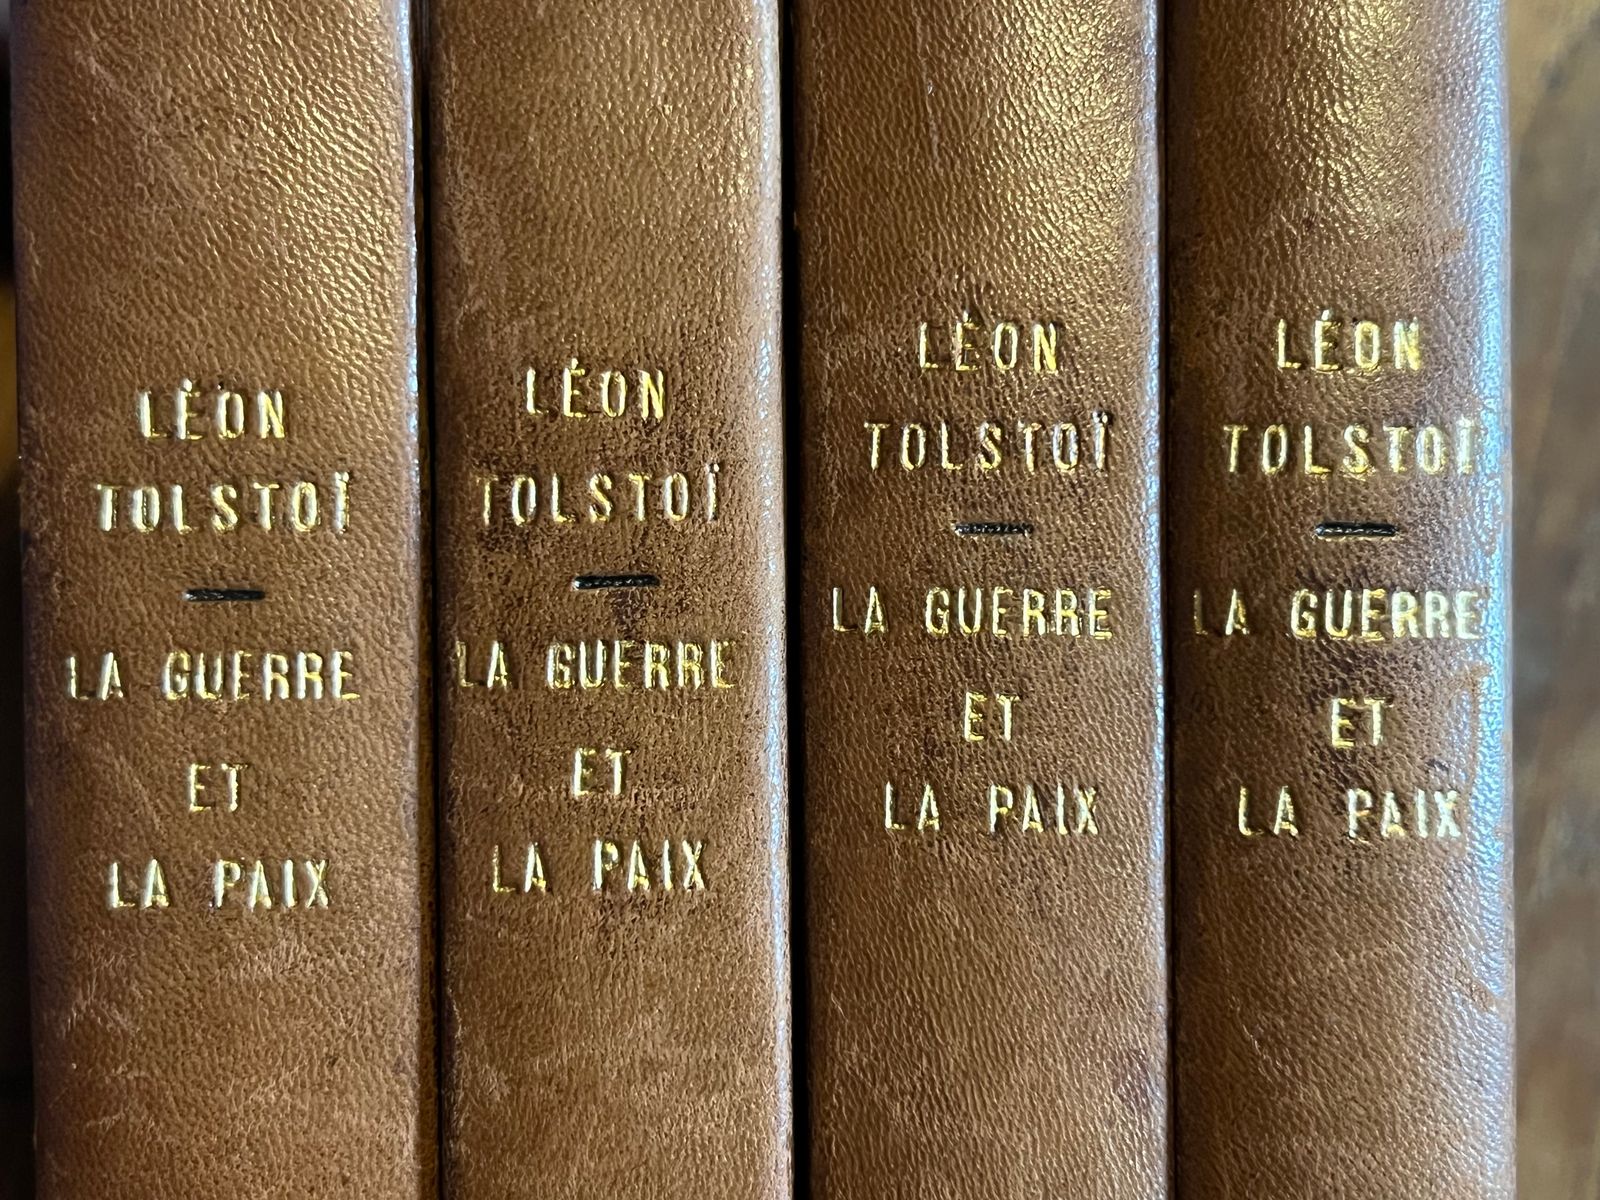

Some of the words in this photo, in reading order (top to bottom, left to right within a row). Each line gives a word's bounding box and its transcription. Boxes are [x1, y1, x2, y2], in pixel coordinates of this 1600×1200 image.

[919, 310, 1058, 374] LÉON
[1277, 308, 1421, 373] LÉON
[137, 378, 285, 440] LÉON
[526, 358, 664, 420] LÉON
[864, 411, 1110, 474] TOLSTOÏ
[94, 471, 350, 535] TOLSTOÏ
[475, 463, 720, 526] TOLSTOÏ
[833, 586, 888, 635] LA
[925, 586, 1113, 640] GUERRE
[1194, 588, 1249, 636] LA
[1290, 588, 1480, 642] GUERRE
[67, 651, 124, 700] LA
[163, 650, 360, 700] GUERRE
[456, 640, 508, 690] LA
[547, 640, 735, 690] GUERRE
[964, 691, 1020, 742] ET
[1331, 696, 1388, 748] ET
[189, 763, 248, 812] ET
[572, 747, 631, 797] ET
[885, 781, 940, 833] LA
[989, 783, 1099, 836] PAIX
[1238, 785, 1299, 837] LA
[1348, 787, 1461, 840] PAIX
[109, 859, 170, 909] LA
[212, 858, 329, 909] PAIX
[492, 842, 547, 893] LA
[593, 839, 705, 893] PAIX
